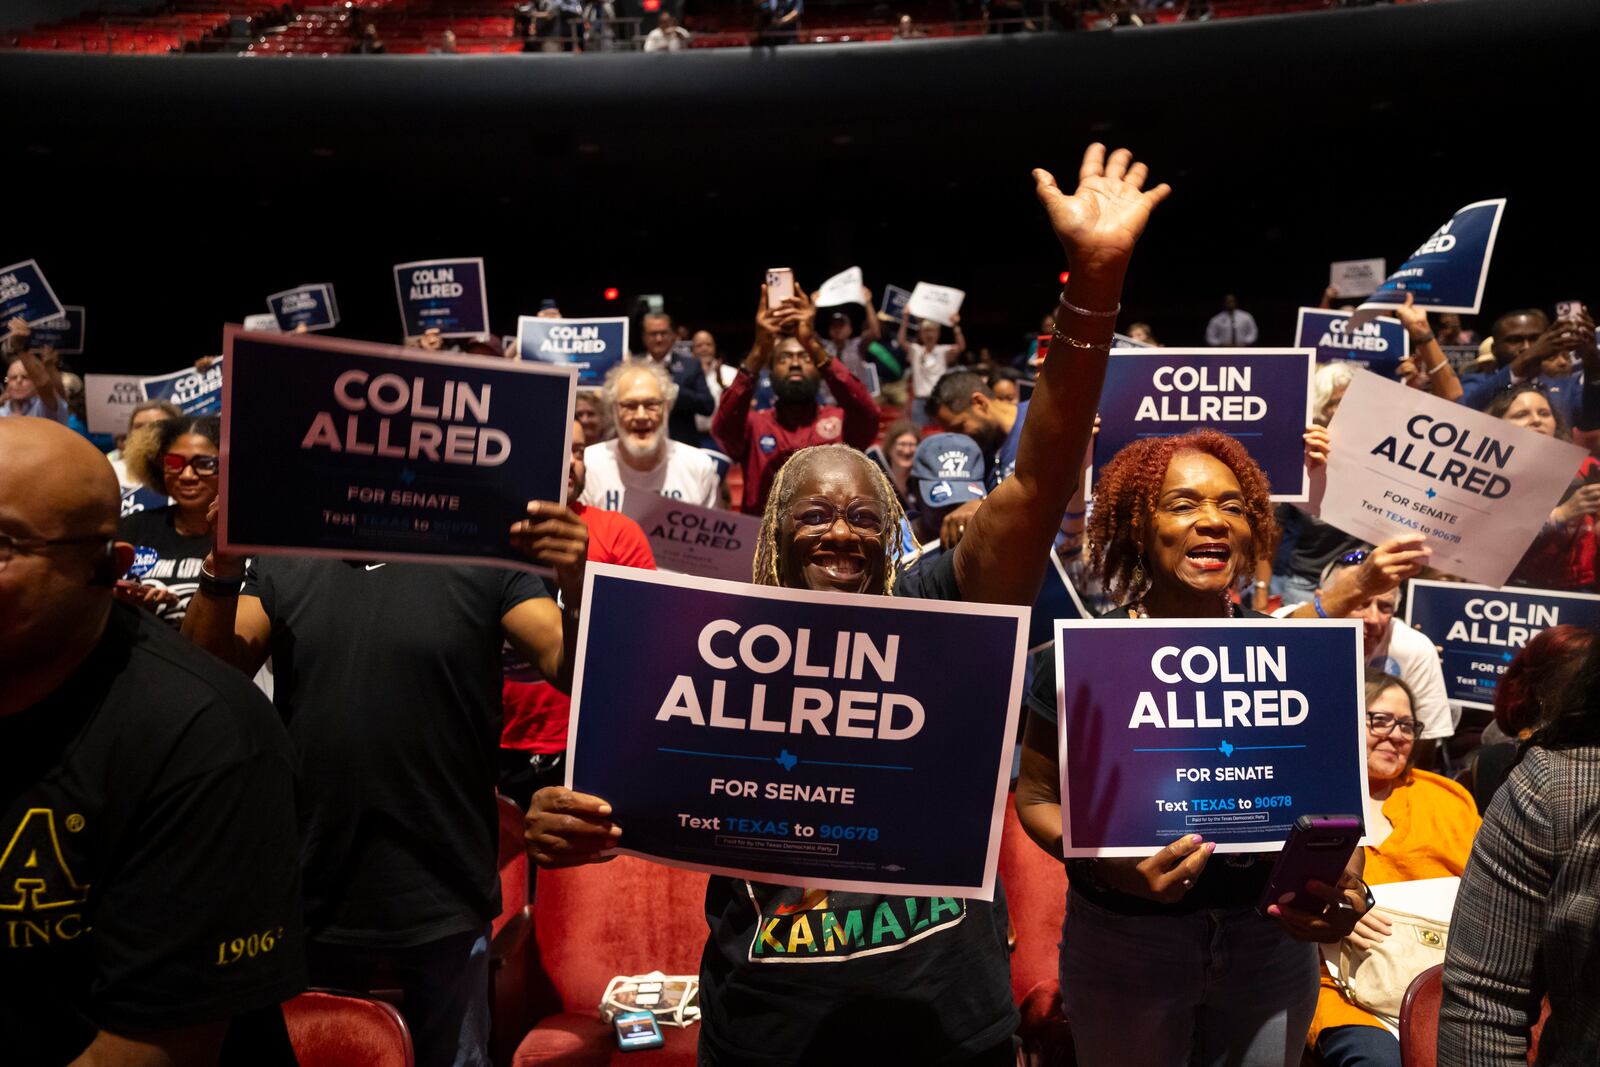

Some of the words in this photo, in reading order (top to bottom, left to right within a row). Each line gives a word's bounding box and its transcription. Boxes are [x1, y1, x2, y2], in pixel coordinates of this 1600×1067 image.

[412, 268, 454, 285] COLIN
[410, 282, 464, 300] ALLRED
[540, 339, 606, 353] ALLRED
[549, 326, 599, 340] COLIN
[1319, 332, 1388, 352] ALLRED
[1152, 366, 1251, 392] COLIN
[334, 370, 491, 424] COLIN
[1134, 396, 1267, 422] ALLRED
[301, 411, 512, 467] ALLRED
[1406, 414, 1515, 469] COLIN
[942, 458, 966, 471] 47
[1370, 436, 1511, 500] ALLRED
[347, 486, 385, 504] FOR
[391, 490, 460, 511] SENATE
[1383, 490, 1409, 507] FOR
[1412, 501, 1459, 525] SENATE
[322, 510, 357, 527] Text
[413, 518, 430, 532] to
[667, 510, 737, 535] COLIN
[1361, 499, 1383, 516] Text
[1385, 509, 1419, 529] TEXAS
[1420, 522, 1431, 534] to
[650, 525, 742, 551] ALLRED
[1464, 598, 1559, 627] COLIN
[1446, 620, 1544, 648] ALLR
[698, 619, 900, 682] COLIN
[1151, 645, 1287, 684] COLIN
[1471, 661, 1495, 674] FOR
[655, 674, 925, 740] ALLRED
[1128, 689, 1309, 729] ALLRED
[1176, 767, 1211, 782] FOR
[1215, 766, 1273, 781] SENATE
[710, 778, 757, 799] FOR
[765, 782, 855, 805] SENATE
[1156, 799, 1188, 812] Text
[1192, 798, 1236, 812] TEXAS
[1238, 798, 1252, 810] to
[1254, 796, 1292, 809] 90678
[678, 813, 721, 831] Text
[726, 816, 789, 836] TEXAS
[794, 821, 814, 838] to
[820, 823, 879, 841] 90678
[7, 913, 93, 948] INC.
[755, 896, 961, 953] KAMALA
